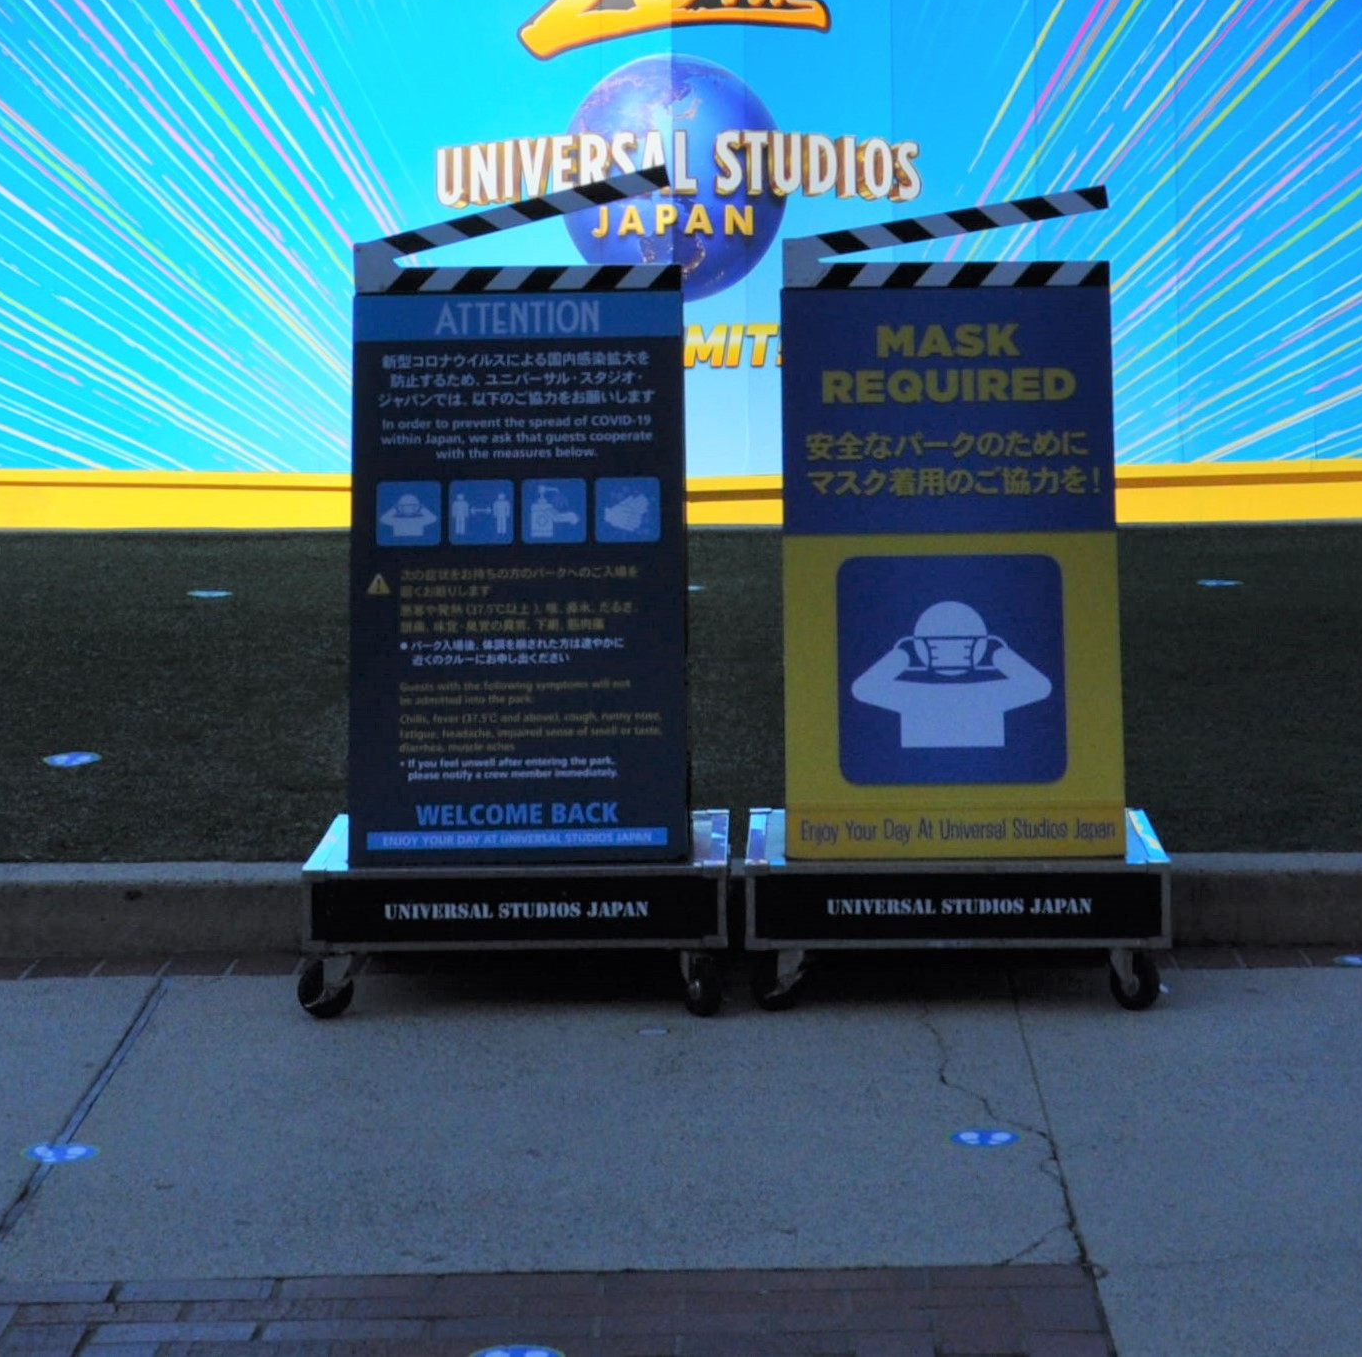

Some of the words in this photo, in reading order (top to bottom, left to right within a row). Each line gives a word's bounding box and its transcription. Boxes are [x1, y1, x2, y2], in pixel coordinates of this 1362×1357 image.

[436, 130, 697, 208] UNIVERSAL
[715, 130, 924, 202] STUDIOS
[591, 205, 755, 236] JAPAN
[435, 300, 599, 335] ATTENTION
[877, 323, 1020, 358] MASK
[822, 368, 1076, 404] REQUIRED
[382, 419, 394, 430] In
[397, 419, 430, 430] order
[435, 419, 448, 429] to
[452, 418, 500, 431] prevent
[504, 417, 524, 428] the
[528, 416, 570, 430] spread
[574, 415, 587, 426] of
[591, 415, 651, 426] COVID-19
[381, 434, 422, 445] within
[426, 434, 464, 447] Japan,
[469, 434, 487, 443] we
[492, 433, 513, 443] ask
[516, 432, 543, 442] that
[546, 432, 586, 445] guests
[589, 431, 652, 444] cooperate
[805, 431, 1088, 461] 安全なパークのために
[437, 449, 464, 459] with
[469, 448, 488, 458] the
[493, 448, 552, 458] measures
[555, 447, 597, 457] below.
[464, 681, 480, 691] the
[488, 694, 505, 704] the
[419, 759, 437, 770] you
[440, 758, 458, 768] feel
[461, 757, 495, 767] unwell
[499, 757, 522, 766] after
[524, 756, 567, 769] entering
[571, 756, 587, 766] the
[408, 770, 439, 782] please
[443, 769, 472, 782] notify
[476, 771, 481, 779] a
[484, 770, 507, 779] crew
[511, 768, 552, 778] member
[416, 803, 543, 826] WELCOME
[552, 802, 618, 824] BACK
[383, 835, 418, 847] ENJOY
[422, 835, 454, 846] YOUR
[457, 834, 481, 846] DAY
[483, 834, 498, 845] AT
[501, 832, 562, 844] UNIVERSAL
[566, 832, 613, 843] STUDIOS
[615, 831, 651, 843] JAPAN
[801, 819, 837, 845] Enjoy
[845, 820, 876, 842] Your
[883, 818, 912, 843] Day
[918, 818, 933, 840] At
[940, 818, 1007, 840] Universal
[1013, 818, 1067, 840] Studios
[1073, 818, 1115, 842] Japan
[384, 903, 492, 920] UNIVERSAL
[498, 902, 581, 918] STUDIOS
[587, 901, 649, 918] JAPAN
[827, 899, 936, 915] UNIVERSAL
[941, 898, 1025, 915] STUDIOS
[1030, 898, 1092, 915] JAPAN
